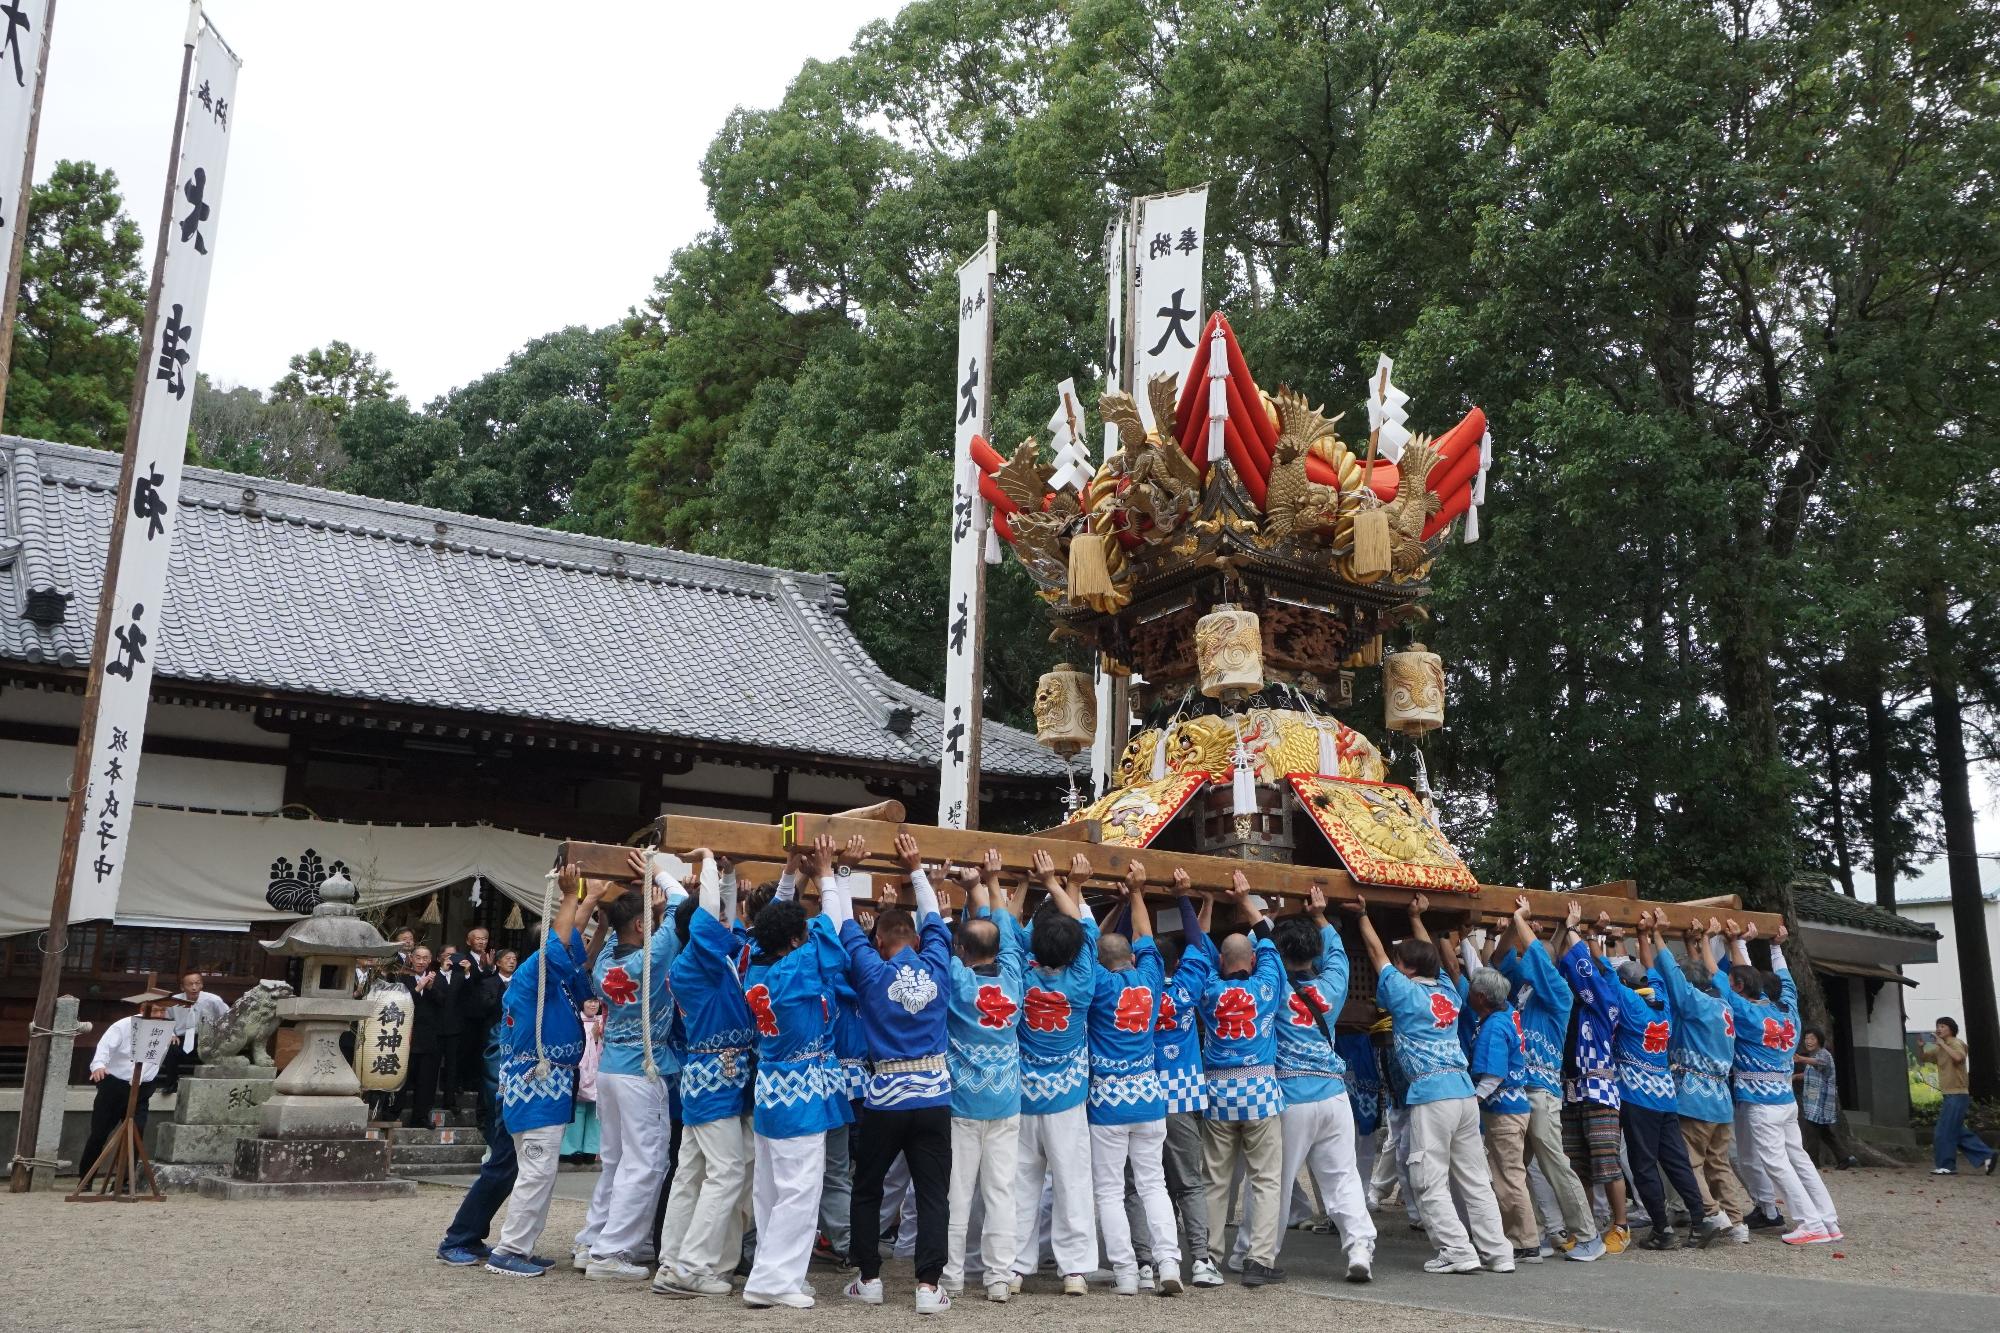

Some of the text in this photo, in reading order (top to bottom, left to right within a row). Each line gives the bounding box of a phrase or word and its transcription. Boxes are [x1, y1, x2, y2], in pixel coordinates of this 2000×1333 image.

[370, 1001, 406, 1076] 御神燈
[1213, 986, 1258, 1040] 祭
[227, 1084, 258, 1110] 納
